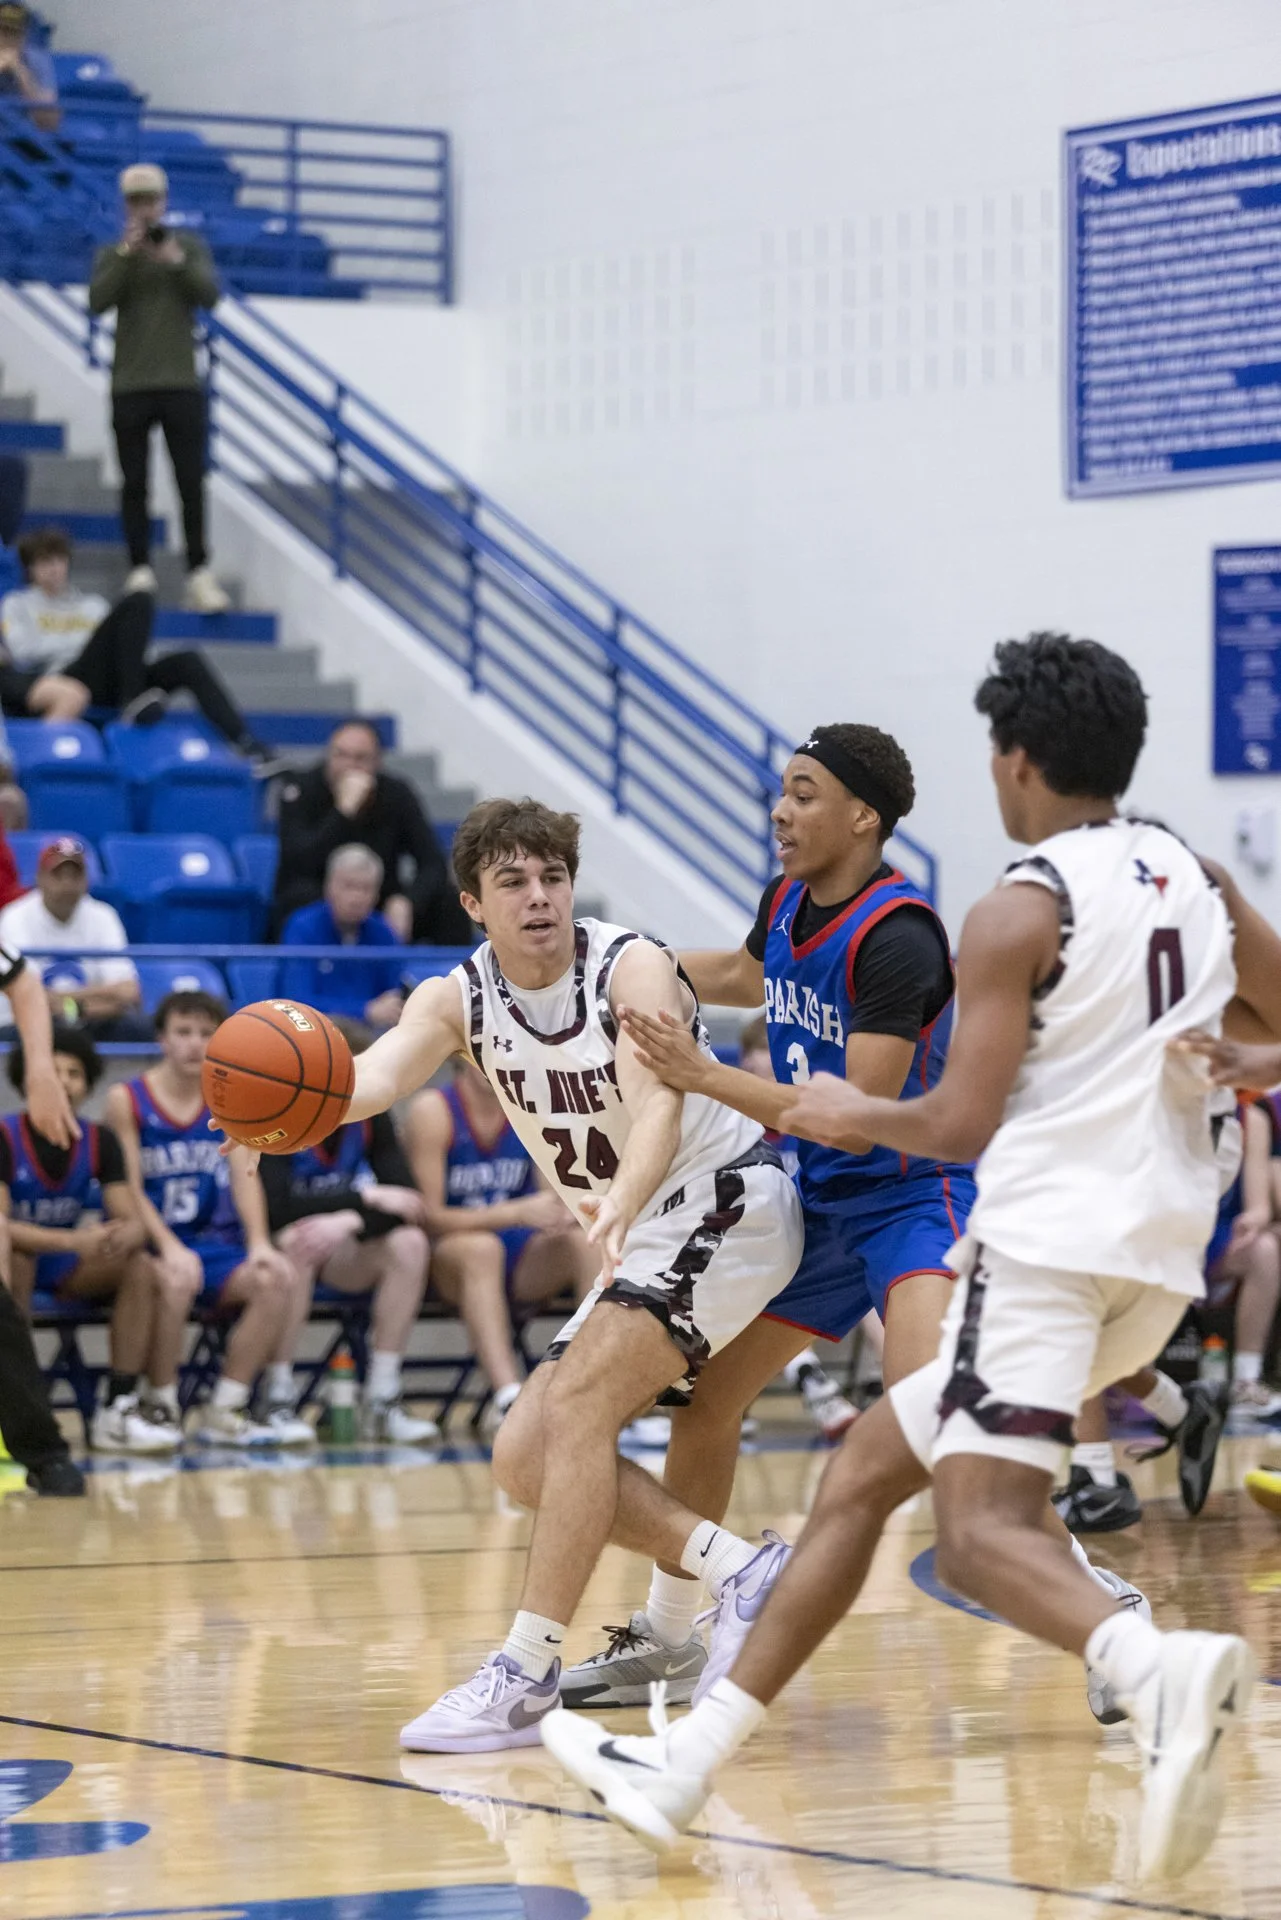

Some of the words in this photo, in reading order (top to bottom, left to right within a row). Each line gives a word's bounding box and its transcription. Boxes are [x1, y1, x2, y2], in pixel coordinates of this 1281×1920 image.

[1147, 927, 1185, 1028] 0
[763, 977, 844, 1048] PARISH
[786, 1042, 810, 1085] 3
[496, 1068, 537, 1114] ST.
[163, 1177, 200, 1223] 15
